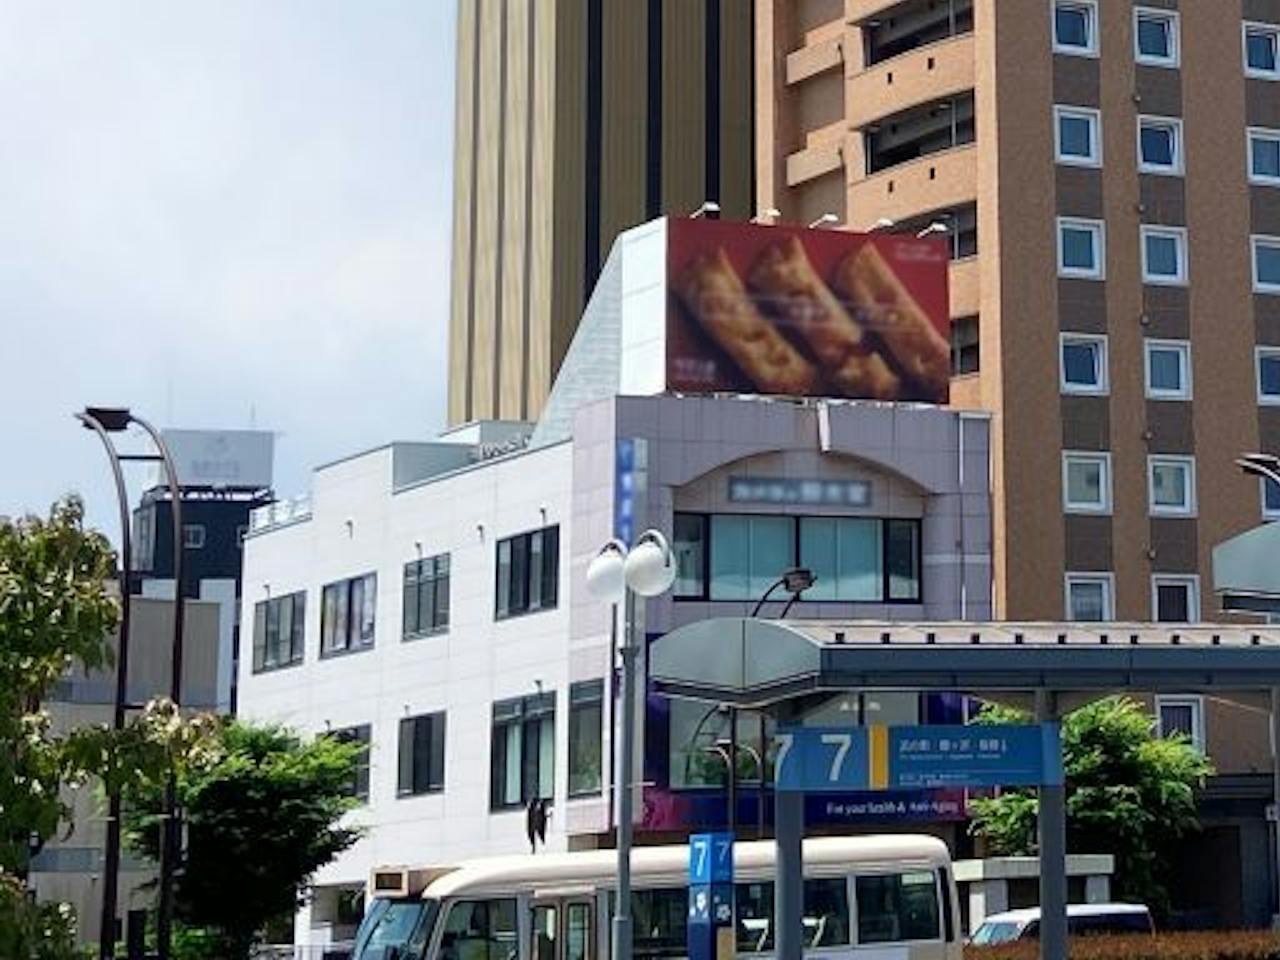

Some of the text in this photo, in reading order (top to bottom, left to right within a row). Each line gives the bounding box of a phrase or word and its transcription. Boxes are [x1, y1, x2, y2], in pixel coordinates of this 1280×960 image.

[821, 734, 852, 781] 7
[694, 842, 706, 877] 7
[716, 842, 730, 863] 7
